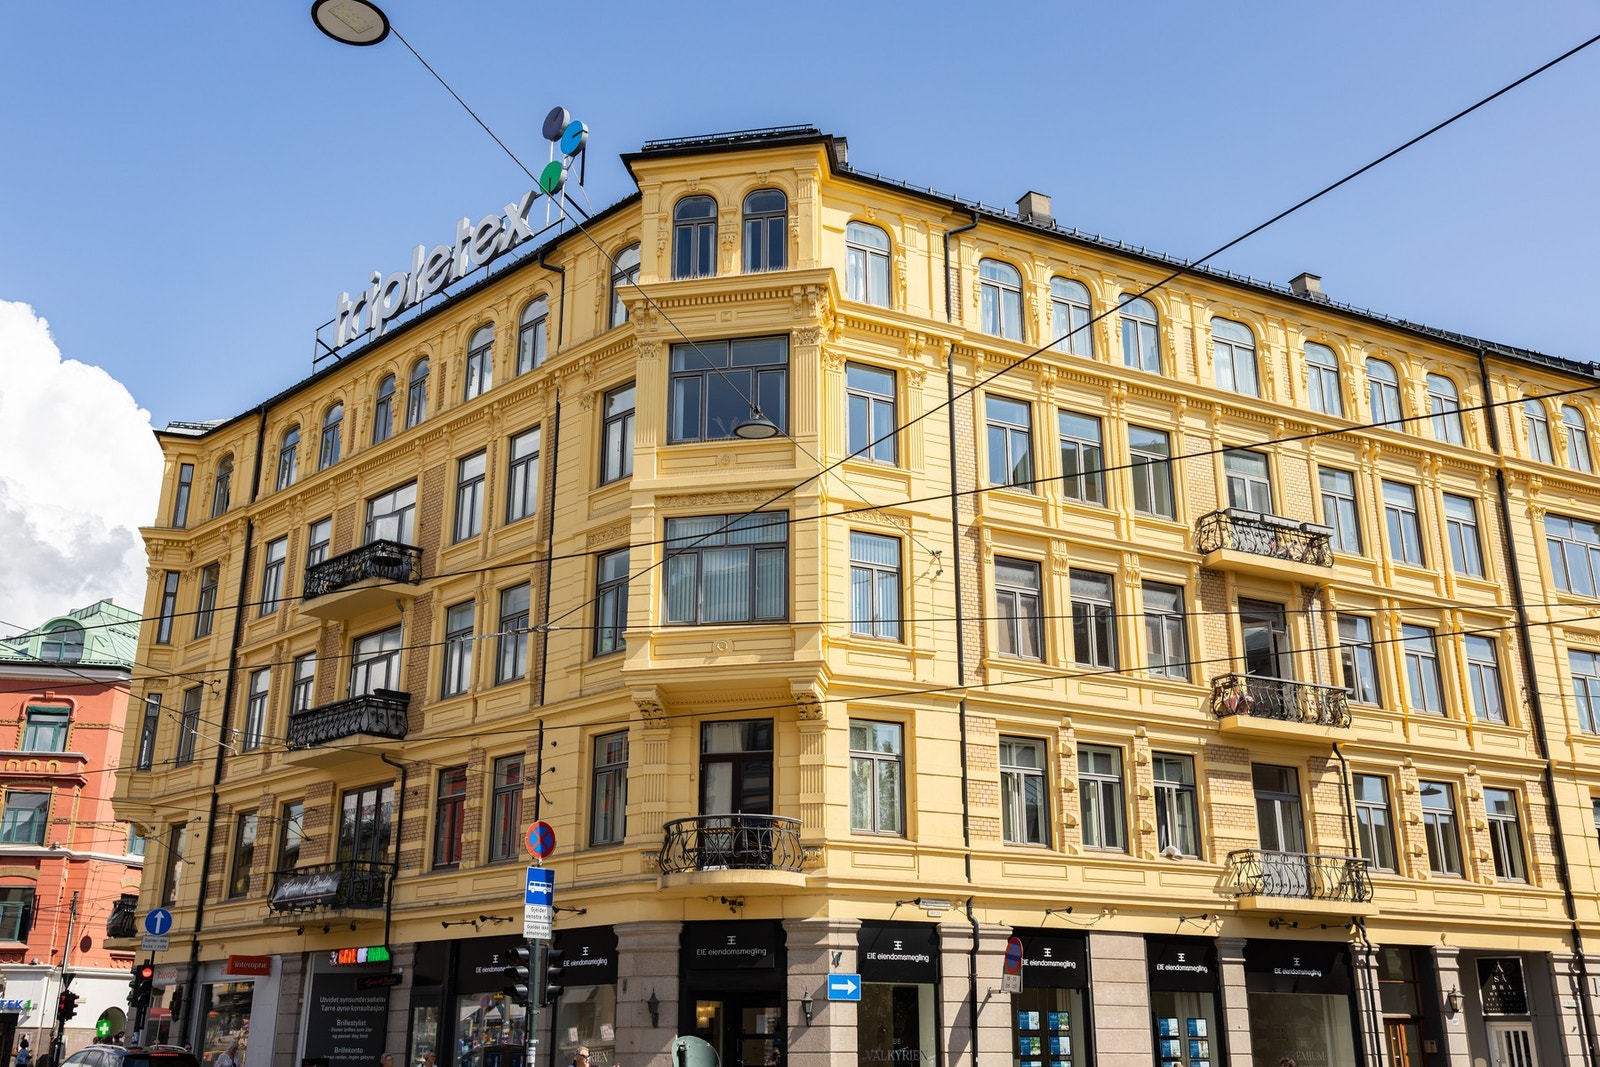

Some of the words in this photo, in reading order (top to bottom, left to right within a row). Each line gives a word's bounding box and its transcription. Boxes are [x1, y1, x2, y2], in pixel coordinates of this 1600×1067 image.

[333, 190, 537, 349] tripletex
[708, 948, 767, 956] eiendomsmegling
[570, 957, 608, 967] eiendomsmegling
[877, 952, 930, 963] eiendomsmegling
[1029, 959, 1076, 969] eiendomsmegling
[1165, 964, 1208, 973] eiendomsmegling
[1282, 968, 1322, 977] eiendomsmegling
[25, 1000, 32, 1009] 1
[337, 1005, 351, 1013] øyne
[336, 1019, 367, 1027] Brillestylist
[334, 1046, 364, 1054] Brillekonto
